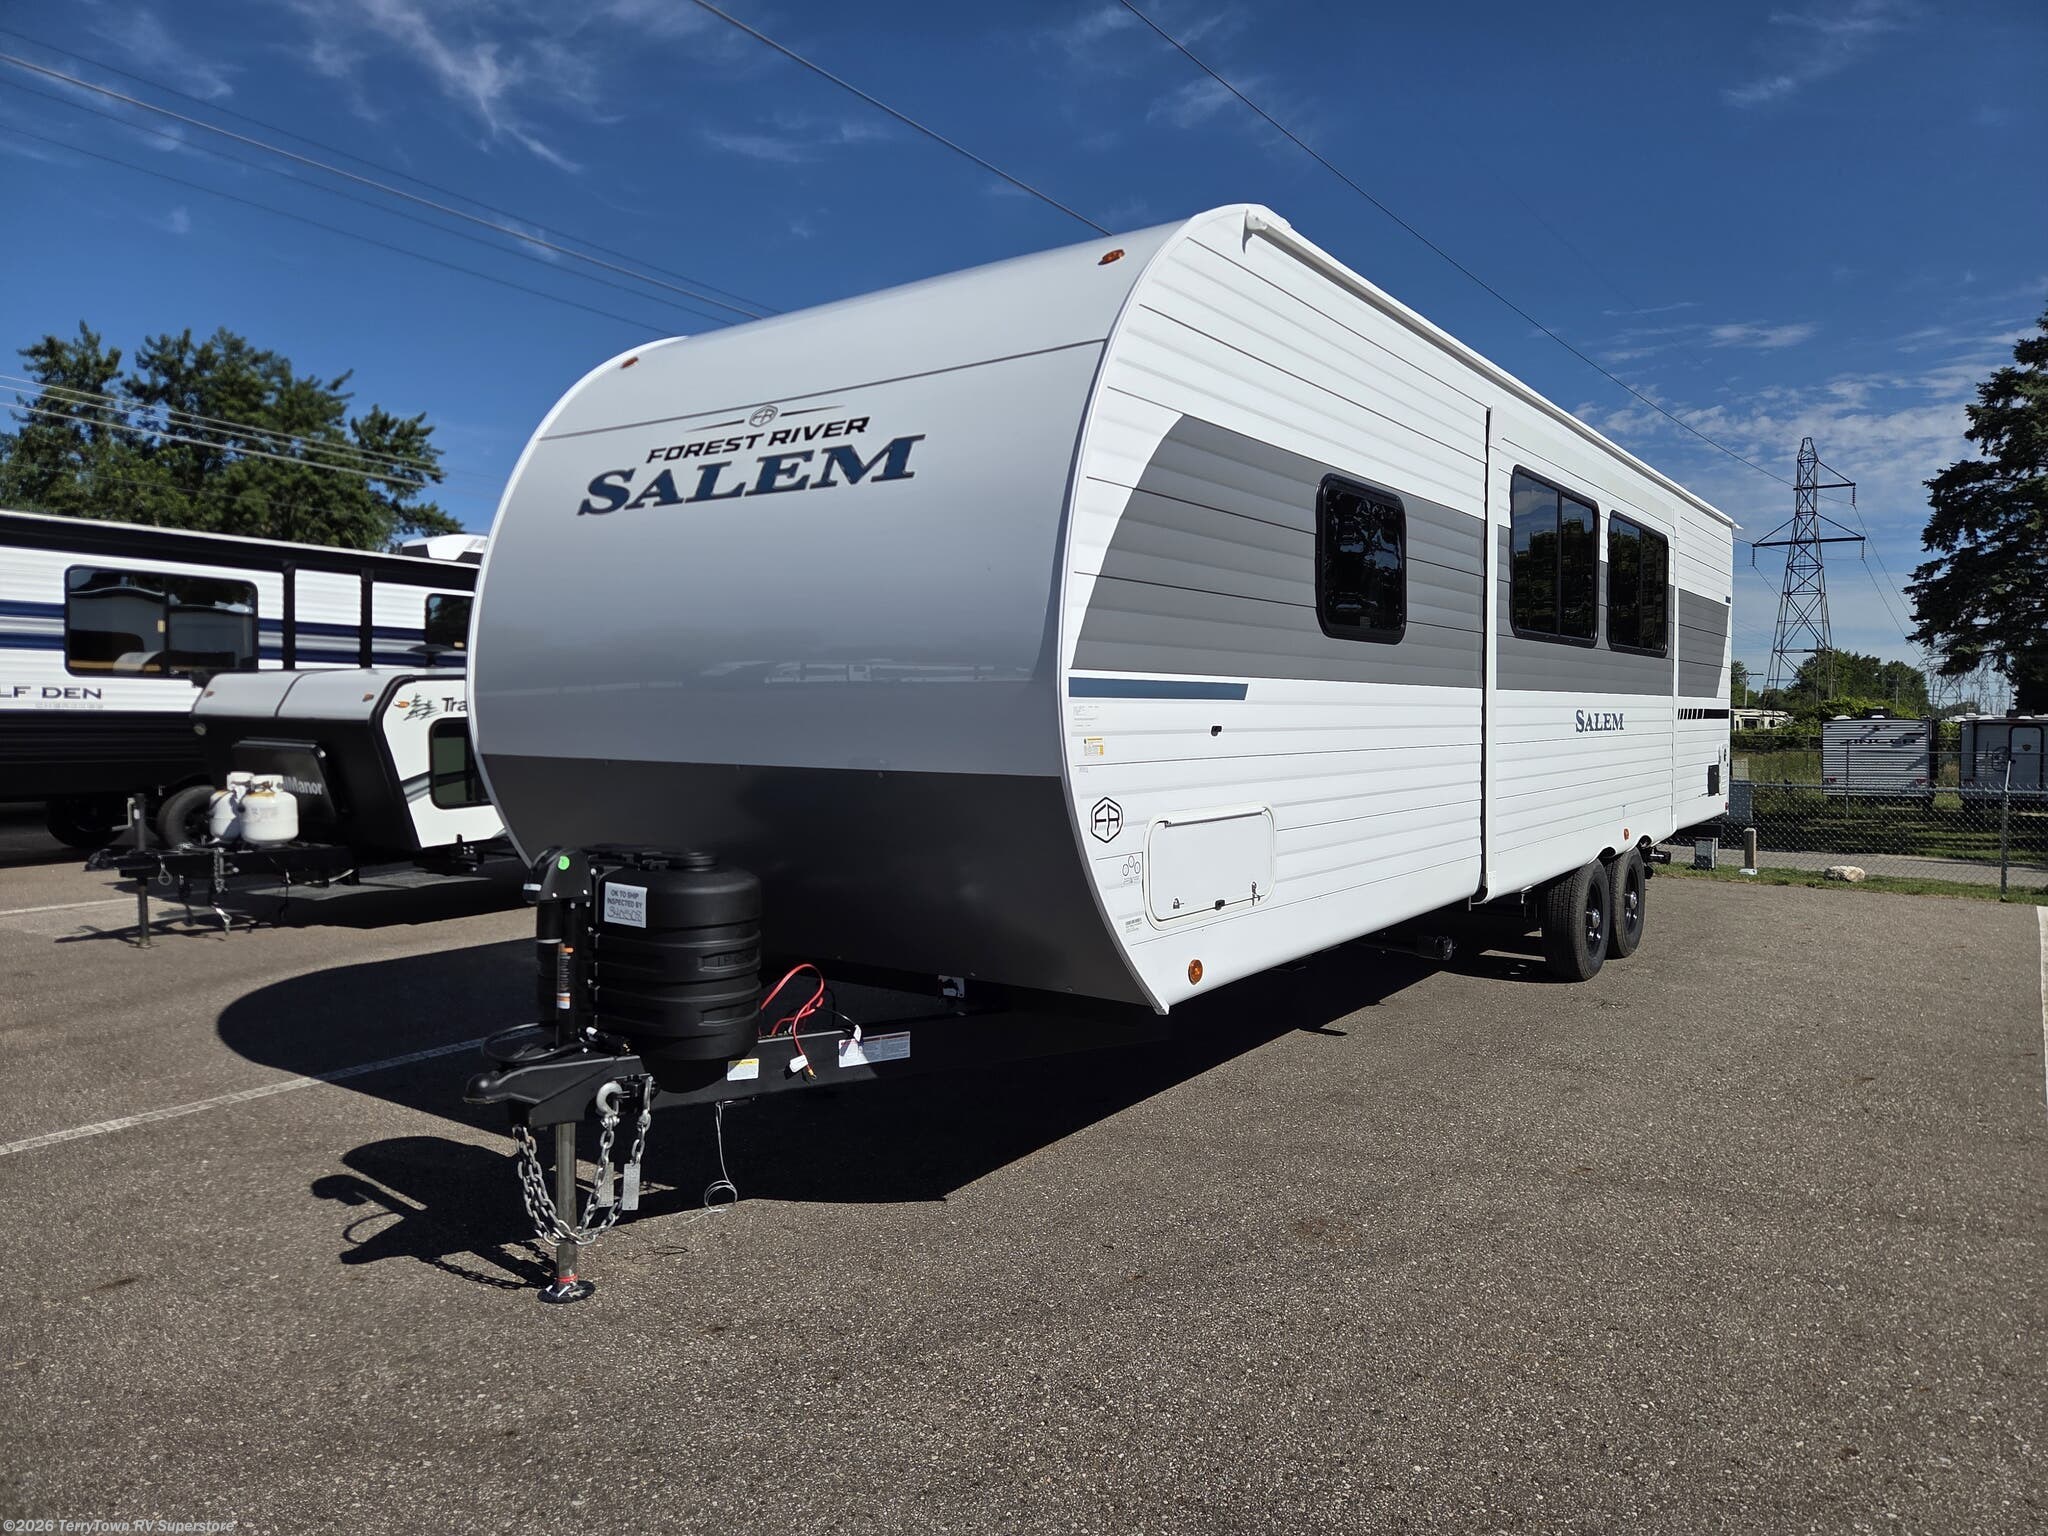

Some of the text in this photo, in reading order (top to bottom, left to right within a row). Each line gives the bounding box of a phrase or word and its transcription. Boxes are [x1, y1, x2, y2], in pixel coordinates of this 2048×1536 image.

[645, 416, 871, 464] FOREST RIVER
[577, 434, 926, 516] SALEM
[42, 686, 102, 700] DEN
[1575, 709, 1625, 733] SALEM
